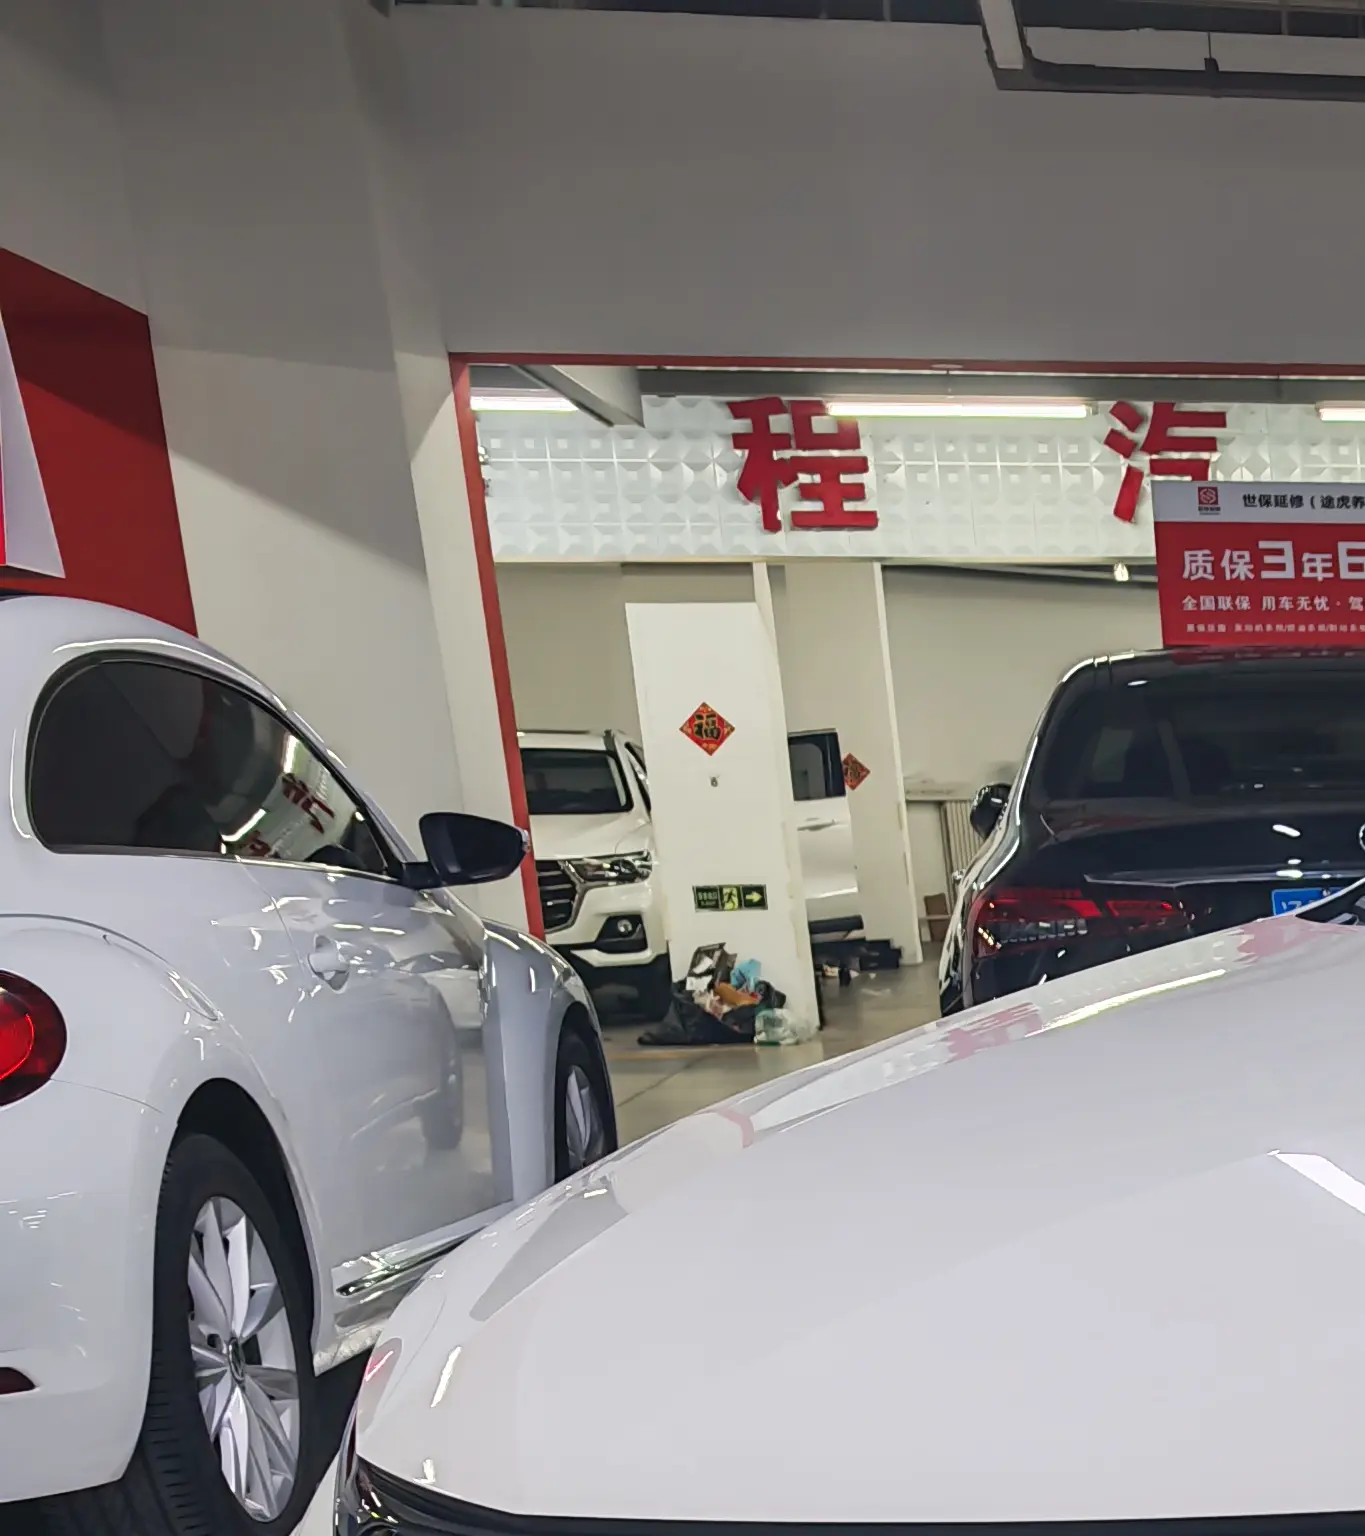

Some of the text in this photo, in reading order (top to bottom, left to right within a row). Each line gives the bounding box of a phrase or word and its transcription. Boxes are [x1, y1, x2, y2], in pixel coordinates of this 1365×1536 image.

[726, 396, 880, 533] 程
[1182, 595, 1251, 612] 全国联保
